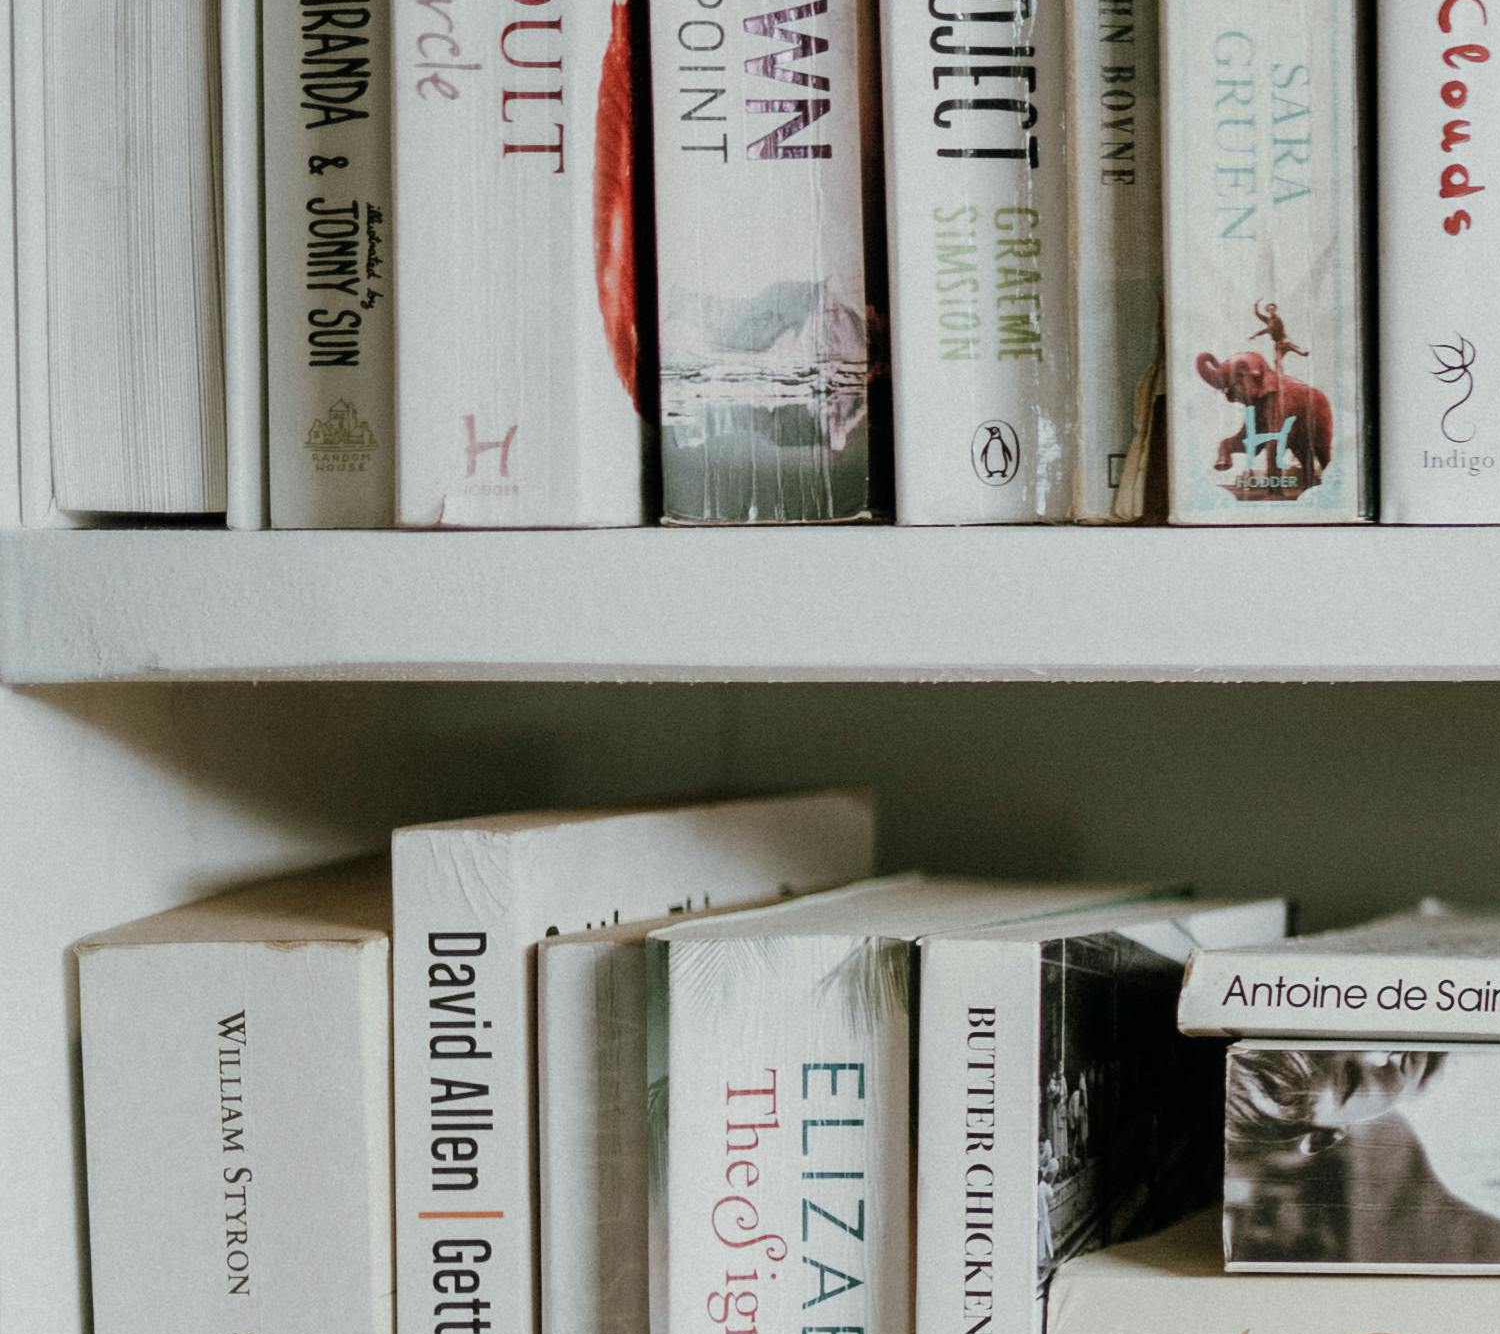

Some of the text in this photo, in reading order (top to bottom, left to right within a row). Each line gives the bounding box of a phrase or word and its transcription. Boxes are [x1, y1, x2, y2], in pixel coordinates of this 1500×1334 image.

[308, 153, 350, 176] &
[306, 197, 361, 307] JONNY
[308, 309, 362, 367] SUN
[1423, 449, 1495, 476] Indigo
[427, 931, 493, 1060] David
[1221, 975, 1367, 1010] Antoine
[1377, 978, 1428, 1012] de
[216, 1009, 248, 1154] WILLIAM
[430, 1076, 494, 1192] Allen
[964, 1005, 997, 1155] BUTTER
[222, 1167, 254, 1297] STYRON
